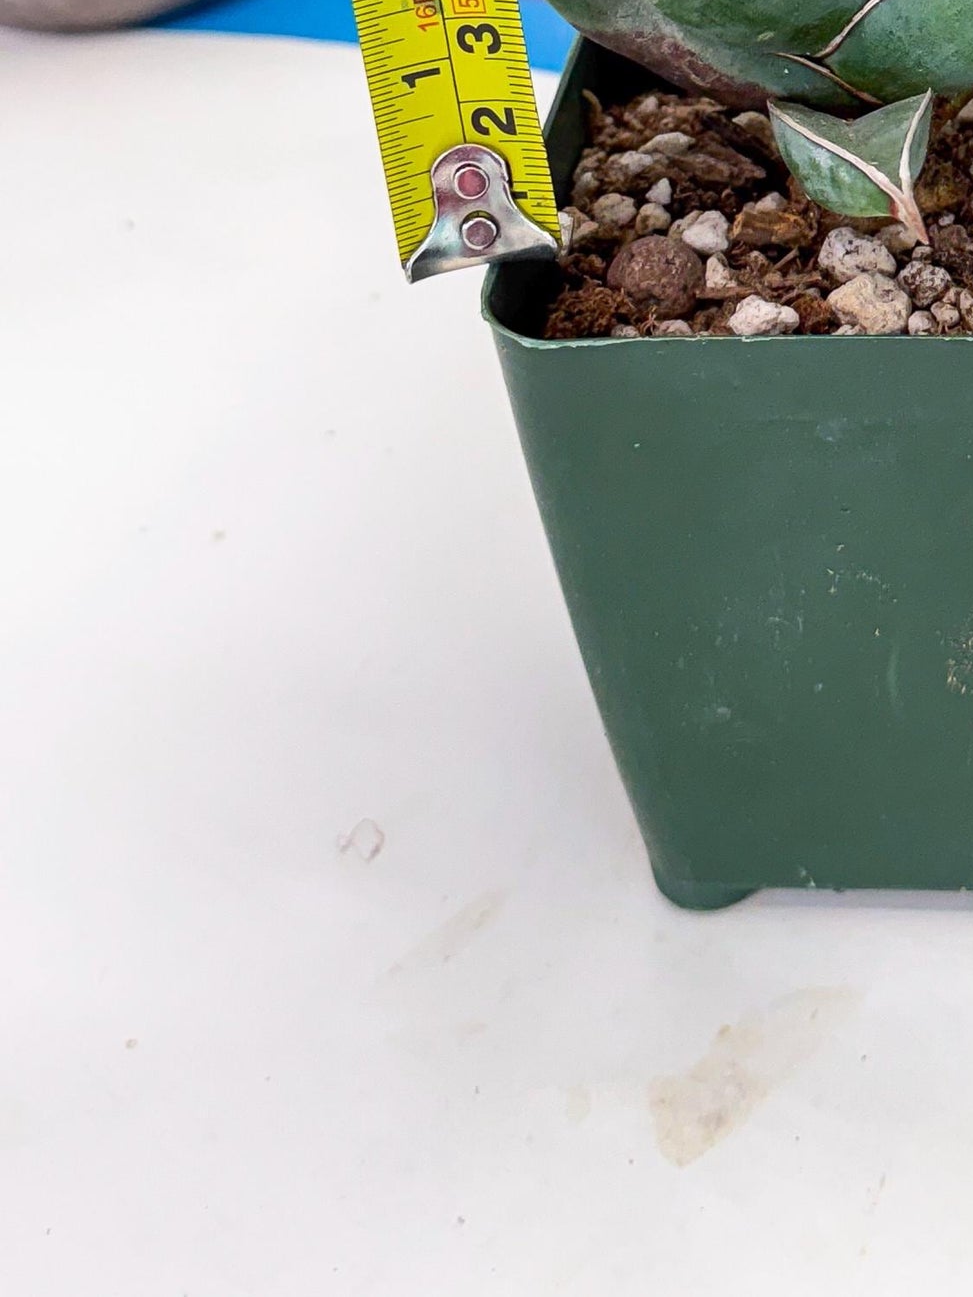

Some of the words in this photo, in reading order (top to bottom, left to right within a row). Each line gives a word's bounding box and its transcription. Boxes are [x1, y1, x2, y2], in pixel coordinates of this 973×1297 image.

[456, 23, 502, 54] 3
[401, 66, 441, 92] 1
[471, 107, 518, 136] 2
